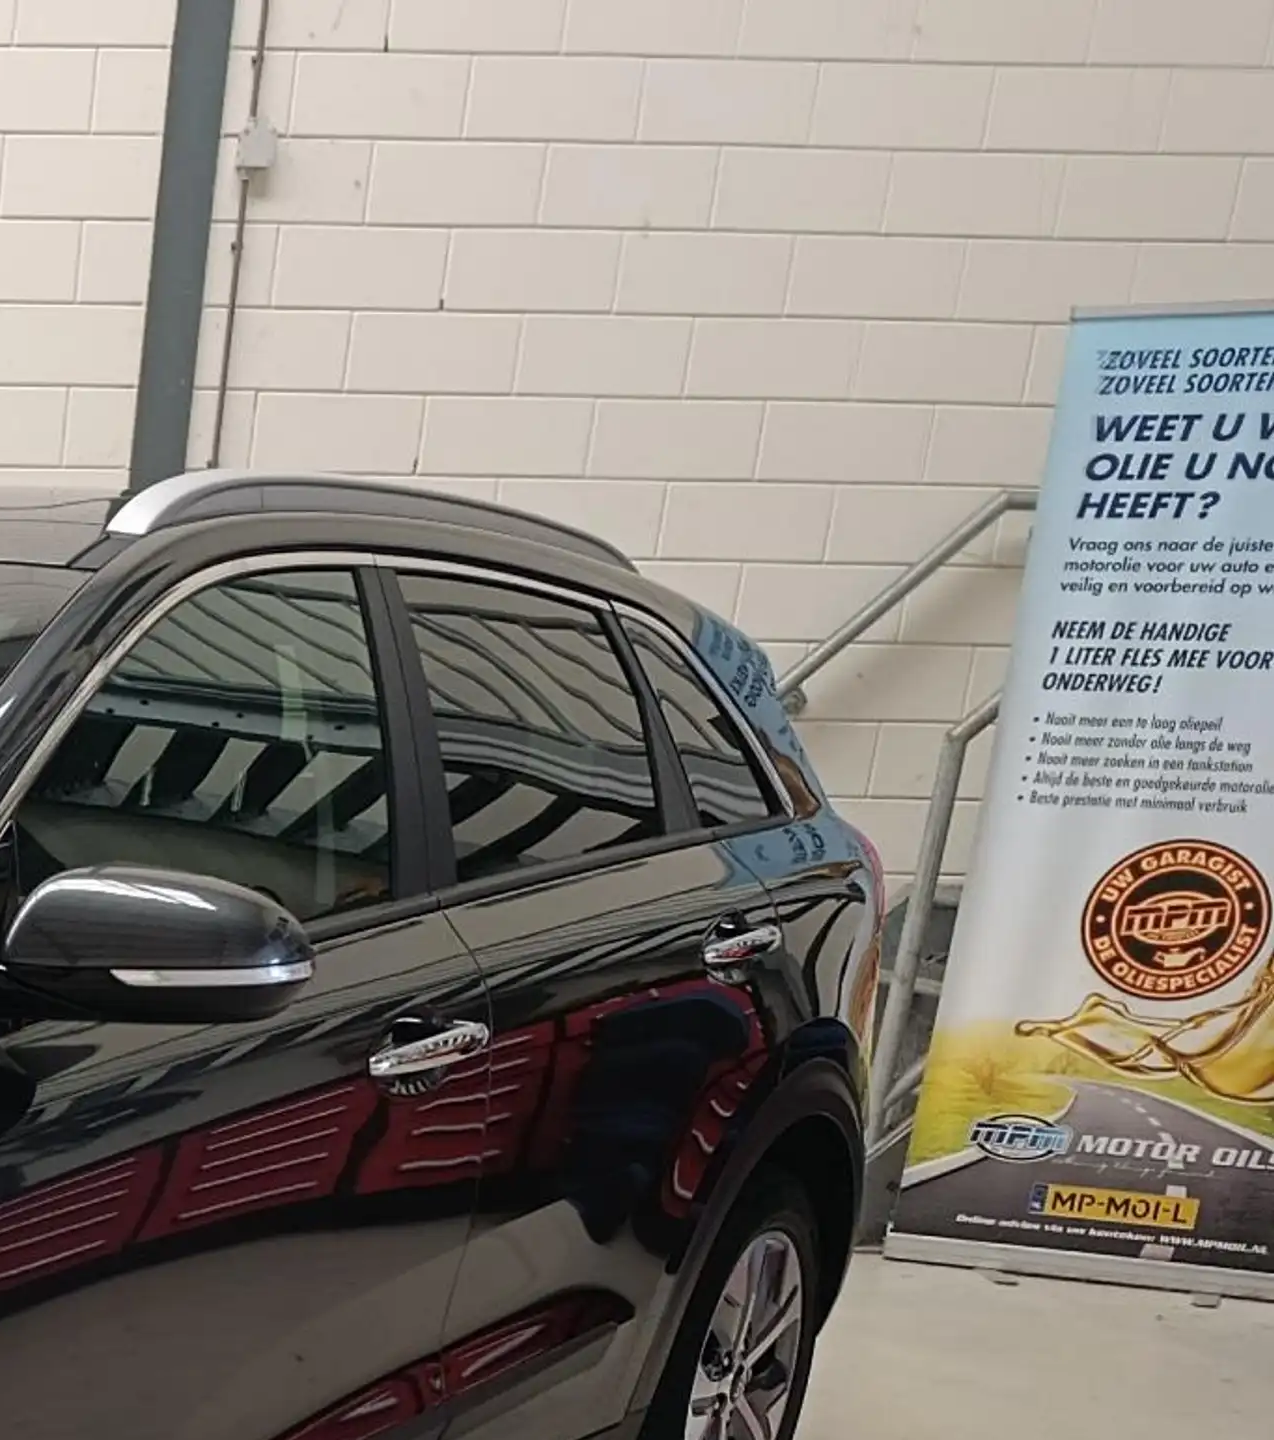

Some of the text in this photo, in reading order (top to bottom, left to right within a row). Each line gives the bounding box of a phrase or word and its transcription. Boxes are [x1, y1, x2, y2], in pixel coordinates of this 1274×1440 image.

[1100, 346, 1274, 371] ZOVEEL SOORTE
[1098, 374, 1176, 395] ZOVEEL
[1095, 413, 1203, 442] WEET
[1212, 413, 1246, 441] U
[1085, 452, 1274, 481] OLIE U N
[1076, 491, 1221, 519] HEEFT?
[1069, 536, 1274, 556] Vraag ons naar de juiste
[1064, 556, 1142, 573] motorolie
[1146, 561, 1185, 573] voor
[1190, 562, 1216, 573] uw
[1221, 560, 1259, 574] auto
[1060, 577, 1104, 596] veilig
[1108, 583, 1128, 593] en
[1134, 577, 1227, 594] voorbereid
[1229, 583, 1253, 598] op
[1052, 620, 1232, 642] NEEM DE HANDIGE
[1050, 646, 1274, 670] 1 LITER FLES MEE VOOR
[1042, 672, 1163, 694] ONDERWEG!
[1209, 737, 1224, 752] de
[1227, 741, 1252, 756] weg
[1065, 773, 1079, 787] de
[1101, 849, 1253, 902] UW GARAGIST
[1093, 924, 1257, 992] DE OLIESPECIALIST
[1076, 1134, 1201, 1164] MOTOR
